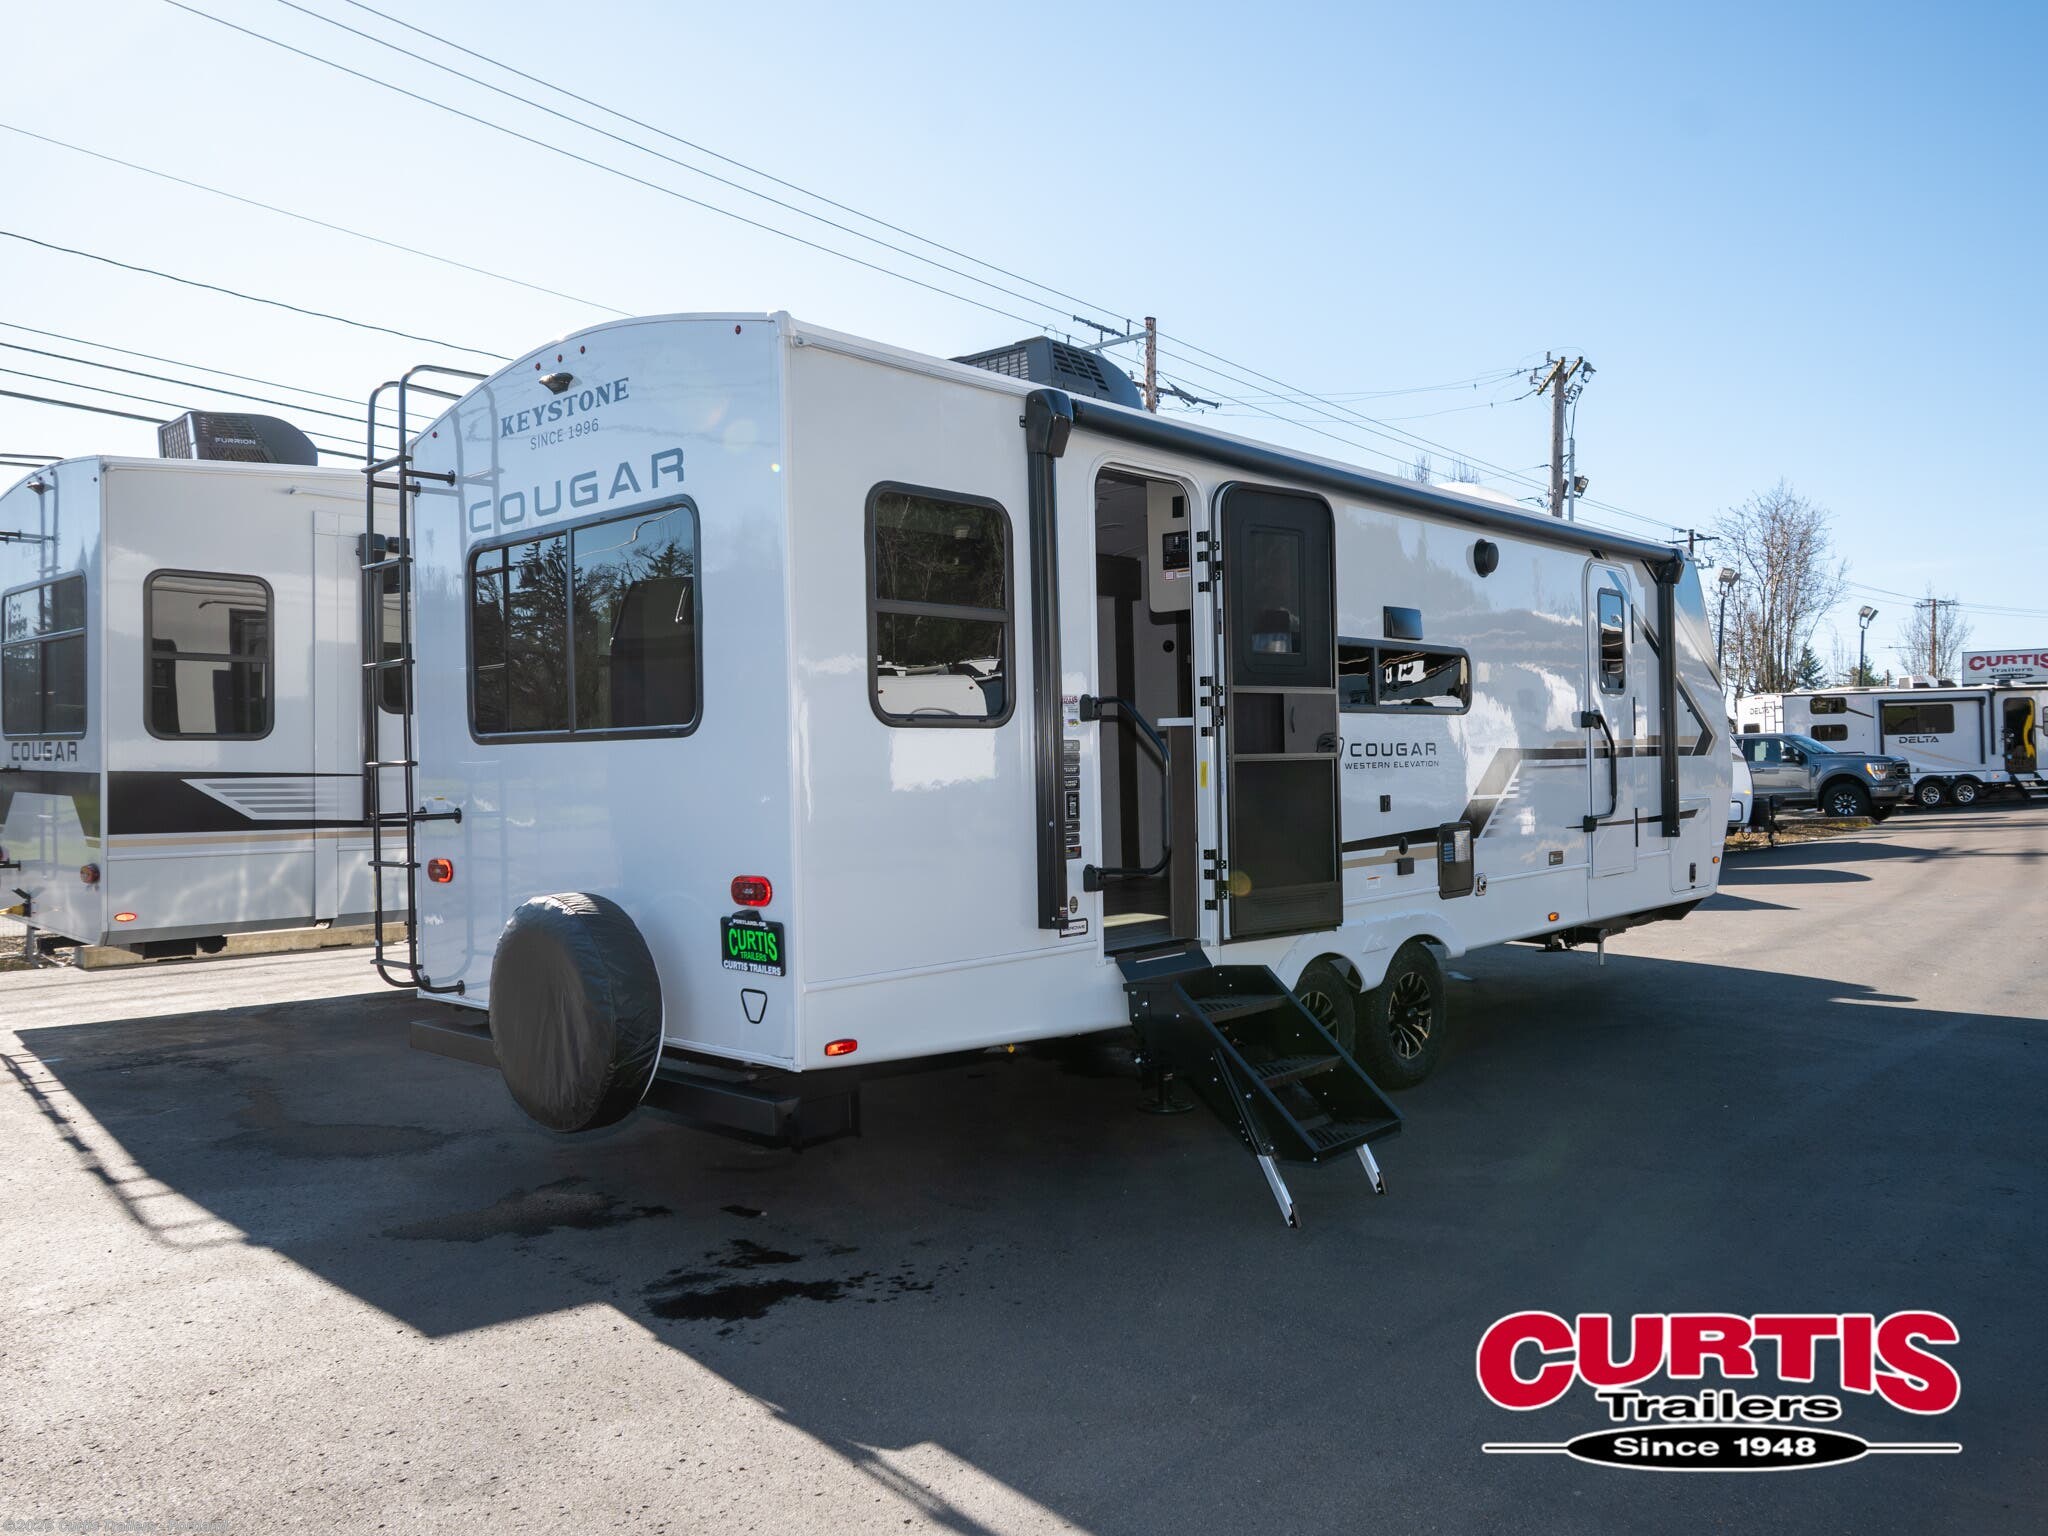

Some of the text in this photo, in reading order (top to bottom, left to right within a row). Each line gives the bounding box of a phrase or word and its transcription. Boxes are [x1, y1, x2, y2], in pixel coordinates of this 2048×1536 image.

[501, 377, 630, 439] KEYSTONE
[214, 437, 256, 445] FURRION
[530, 418, 600, 451] SINCE 1996
[469, 447, 685, 533] COUGAR
[1899, 735, 1939, 744] DELTA
[12, 741, 77, 762] COUGAR
[1350, 742, 1437, 757] COUGAR
[1344, 760, 1440, 770] WESTERN ELEVATION
[728, 928, 777, 961] CURTIS
[740, 951, 767, 962] TRAILERS
[723, 960, 781, 976] CURTIS TRAILERS
